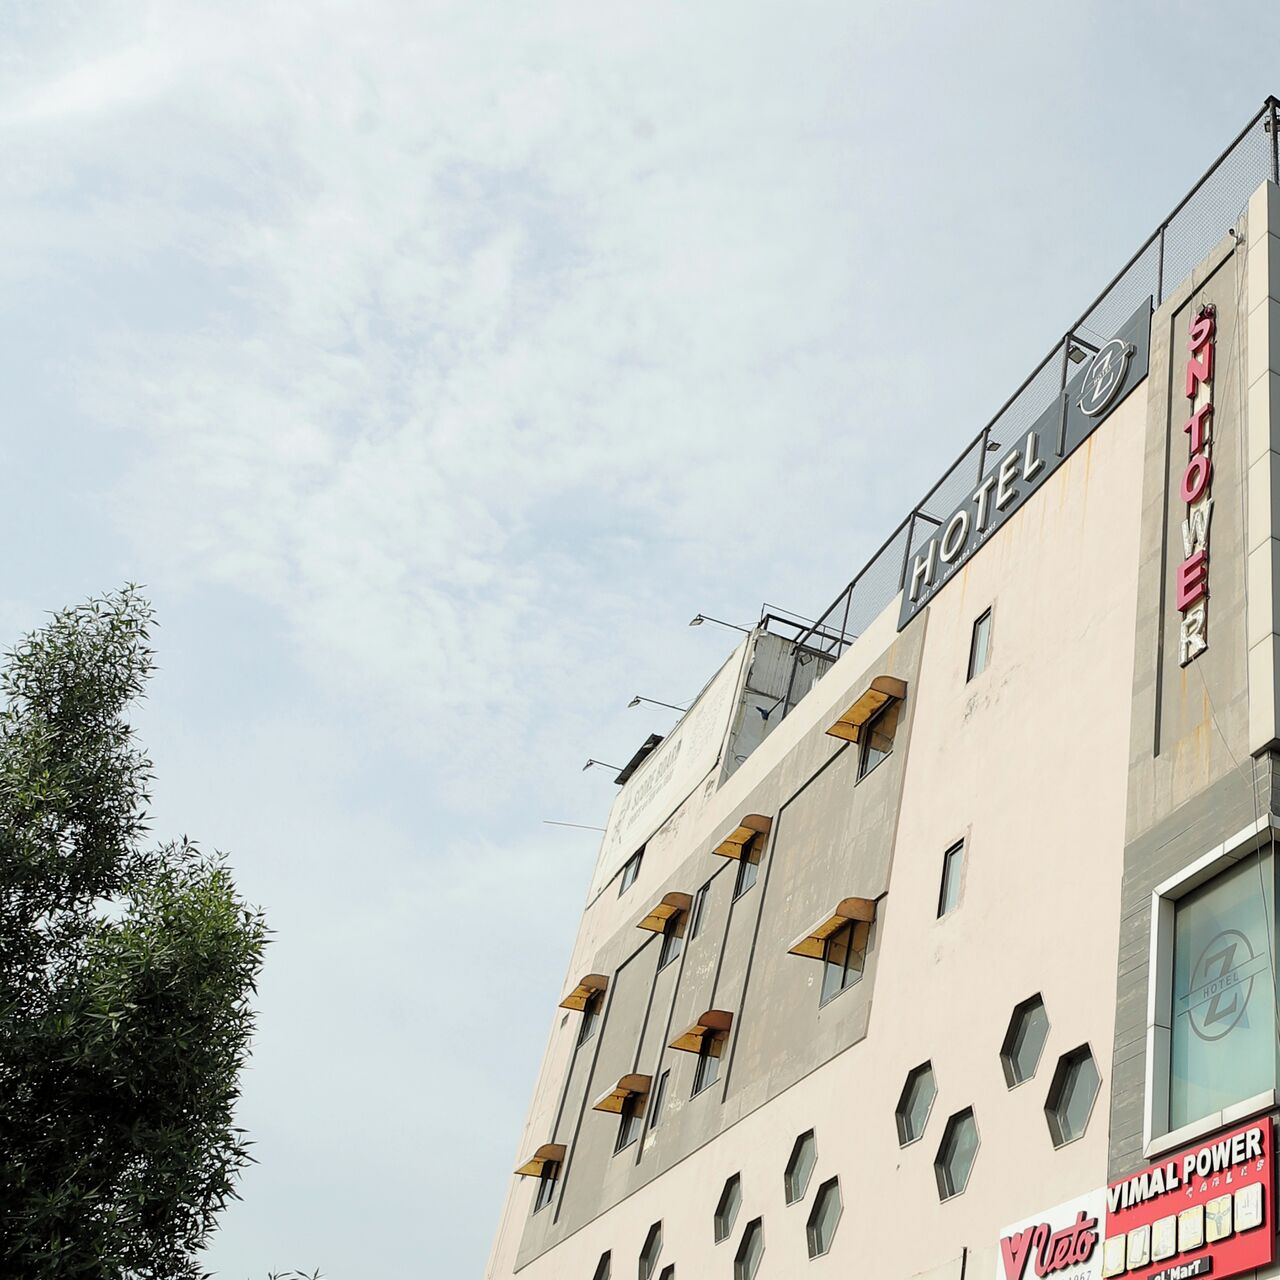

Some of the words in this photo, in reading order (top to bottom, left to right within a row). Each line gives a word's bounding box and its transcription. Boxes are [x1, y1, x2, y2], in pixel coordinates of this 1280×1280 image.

[909, 431, 1045, 603] HOTEL
[1177, 402, 1215, 669] TOWER
[916, 589, 930, 607] UNIT
[932, 579, 941, 591] OF
[979, 521, 997, 542] SONS
[1202, 972, 1239, 999] HOTEL
[1107, 1162, 1180, 1214] VIMAL
[1182, 1126, 1264, 1185] POWER
[1033, 1210, 1099, 1278] Veto
